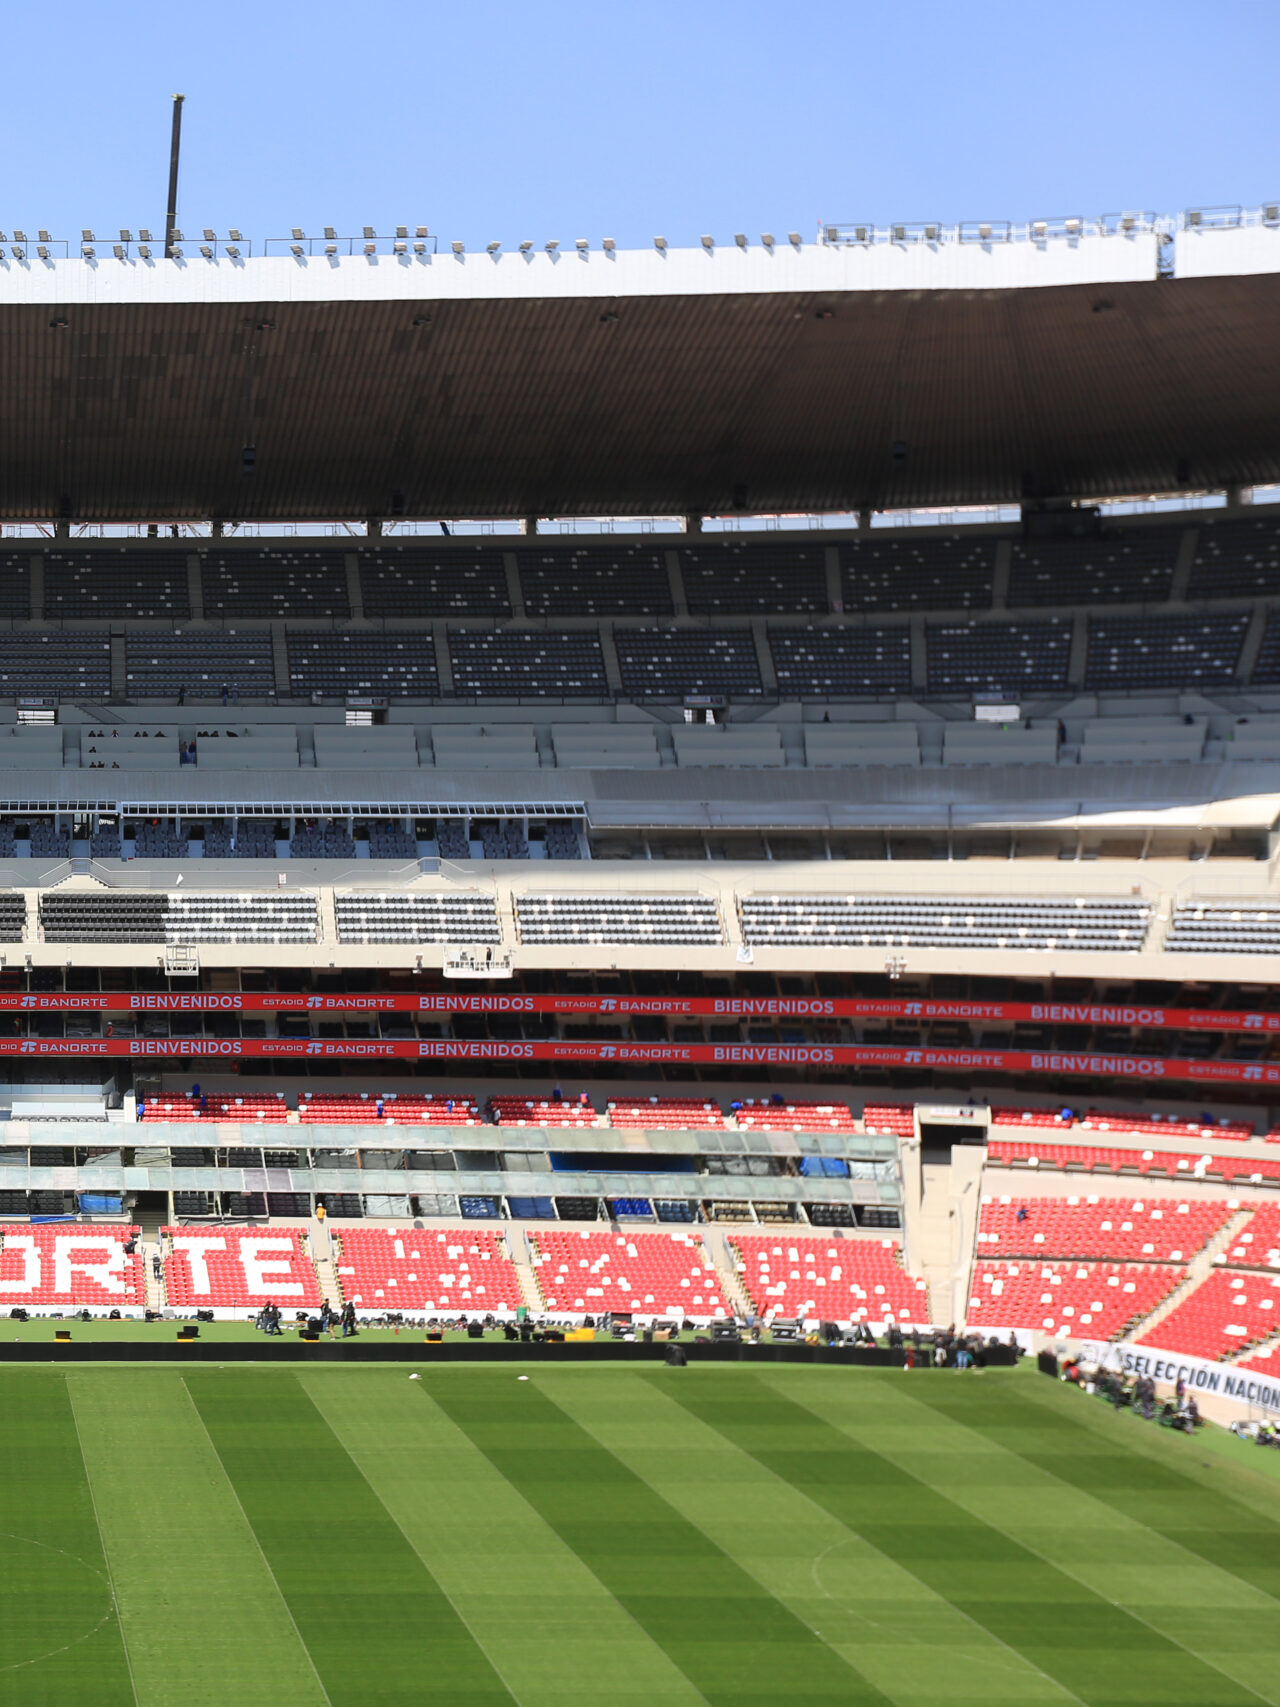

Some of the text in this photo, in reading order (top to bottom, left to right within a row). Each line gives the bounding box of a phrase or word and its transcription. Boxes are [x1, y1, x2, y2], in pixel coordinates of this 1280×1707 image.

[40, 998, 108, 1006] BANORTE
[130, 996, 242, 1008] BIENVENIDOS
[326, 999, 395, 1007] BANORTE
[419, 997, 534, 1010] BIENVENIDOS
[619, 1002, 691, 1011] BANORTE
[714, 1000, 834, 1015] BIENVENIDOS
[1031, 1006, 1165, 1024] BIENVENIDOS
[40, 1043, 108, 1051] BANORTE
[130, 1041, 242, 1054] BIENVENIDOS
[262, 1044, 395, 1052] ESTADIO BANORTE
[419, 1043, 534, 1057] BIENVENIDOS
[619, 1048, 691, 1058] BANORTE
[714, 1047, 834, 1062] BIENVENIDOS
[1031, 1056, 1165, 1075] BIENVENIDOS
[1124, 1353, 1220, 1390] SELECCIÓN
